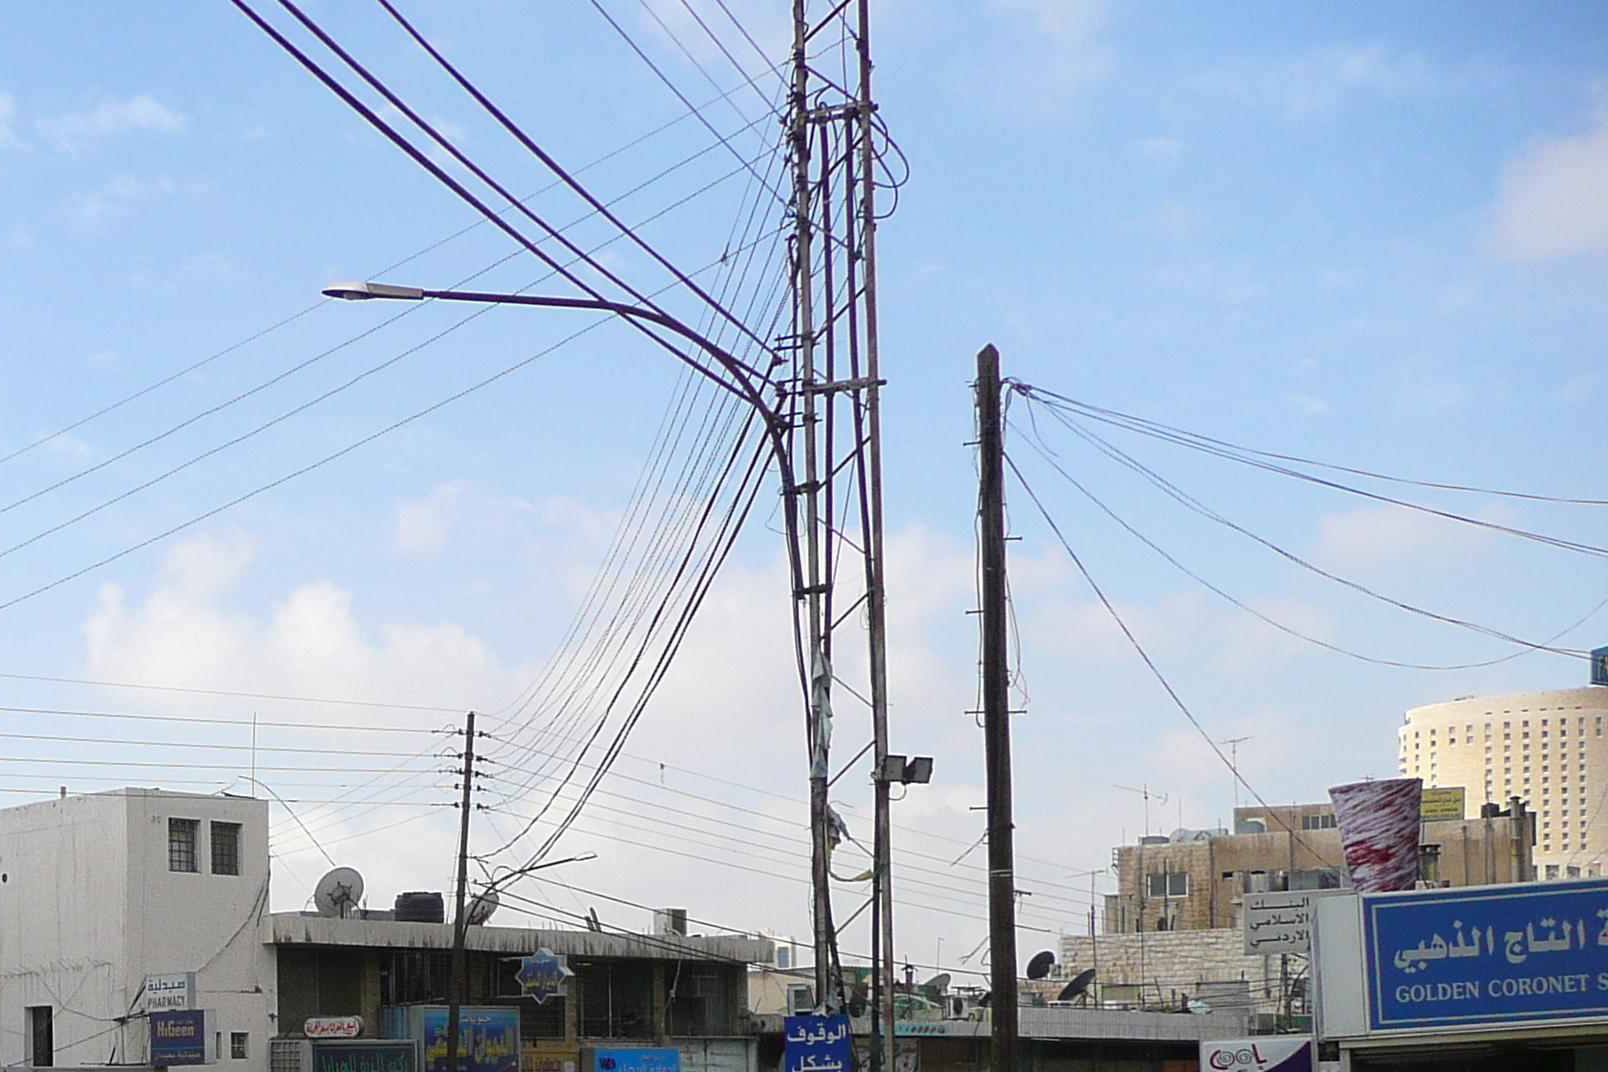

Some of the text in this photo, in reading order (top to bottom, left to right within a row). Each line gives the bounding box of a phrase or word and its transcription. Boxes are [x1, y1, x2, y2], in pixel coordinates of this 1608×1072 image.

[1250, 897, 1309, 911] البنك
[1250, 930, 1309, 948] الاردني
[1394, 919, 1494, 974] الذهبي
[1504, 918, 1586, 964] التاج
[148, 978, 185, 994] صيدلية
[1396, 981, 1480, 1003] GOLDEN
[1488, 974, 1589, 997] CORONET
[148, 995, 185, 1008] PHARMACY
[787, 1022, 846, 1045] الوقوف
